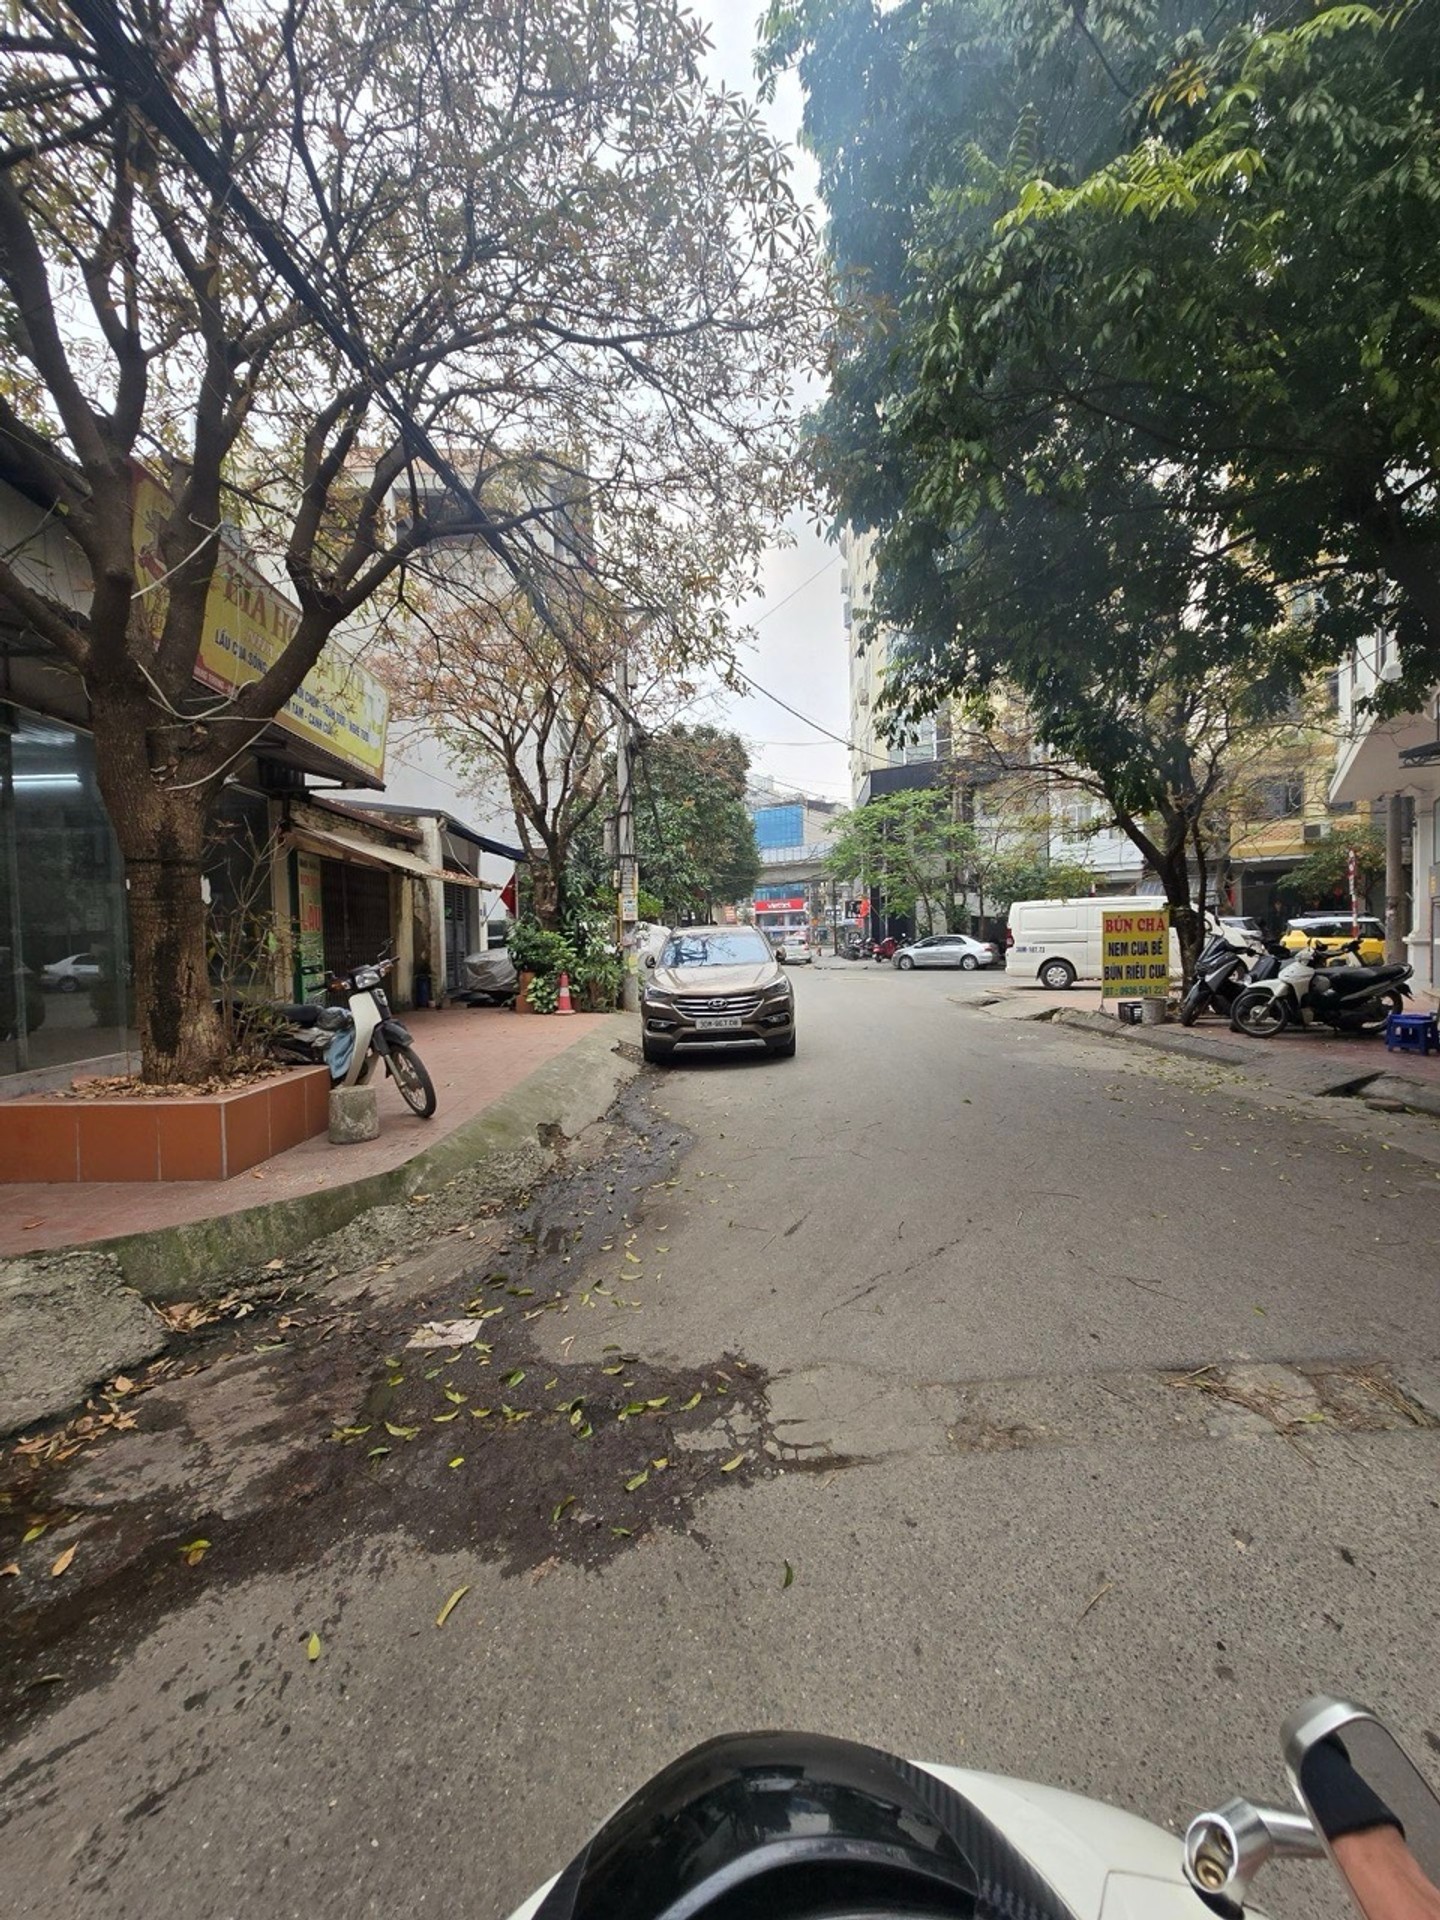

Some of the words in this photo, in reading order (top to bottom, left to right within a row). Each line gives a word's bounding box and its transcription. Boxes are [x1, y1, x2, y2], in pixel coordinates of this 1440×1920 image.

[1105, 915, 1133, 932] BÚN
[1108, 942, 1128, 956] NEM
[1131, 941, 1148, 956] CUA
[1149, 964, 1166, 979] CUA
